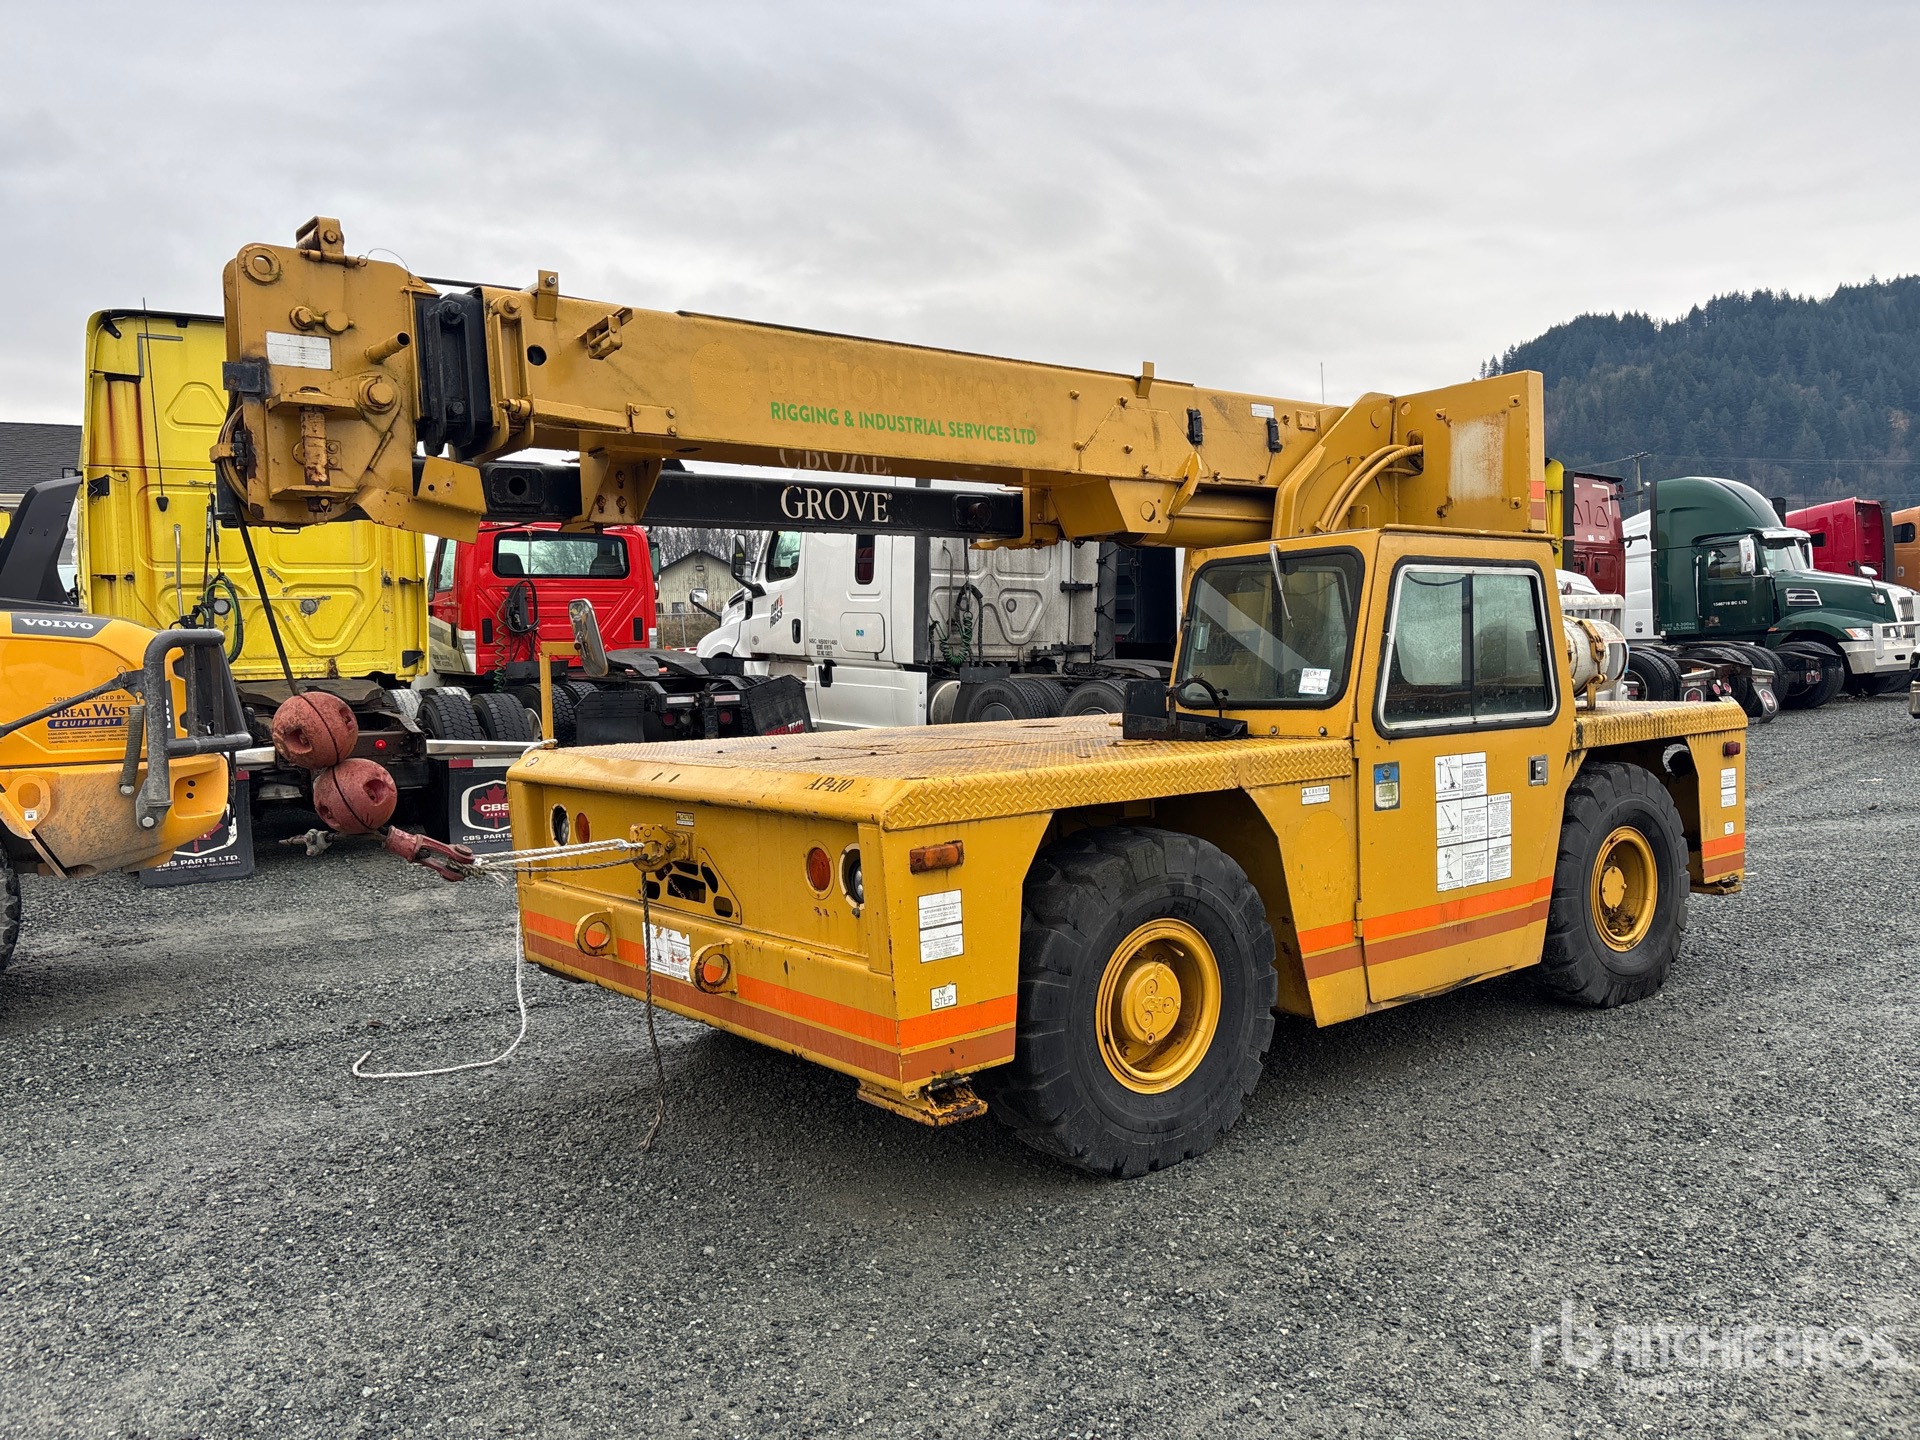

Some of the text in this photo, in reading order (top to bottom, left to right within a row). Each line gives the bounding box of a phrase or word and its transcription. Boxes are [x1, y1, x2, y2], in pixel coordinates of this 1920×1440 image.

[771, 401, 1037, 446] RIGGING & INDUSTRIAL SERVICES LTD
[20, 618, 94, 630] VOLVO
[55, 718, 118, 727] EQUIPMENT
[1308, 787, 1329, 795] CAUTION
[481, 803, 509, 812] CBS
[156, 860, 177, 868] BS
[180, 857, 216, 866] PARTS
[934, 994, 954, 1007] STEP
